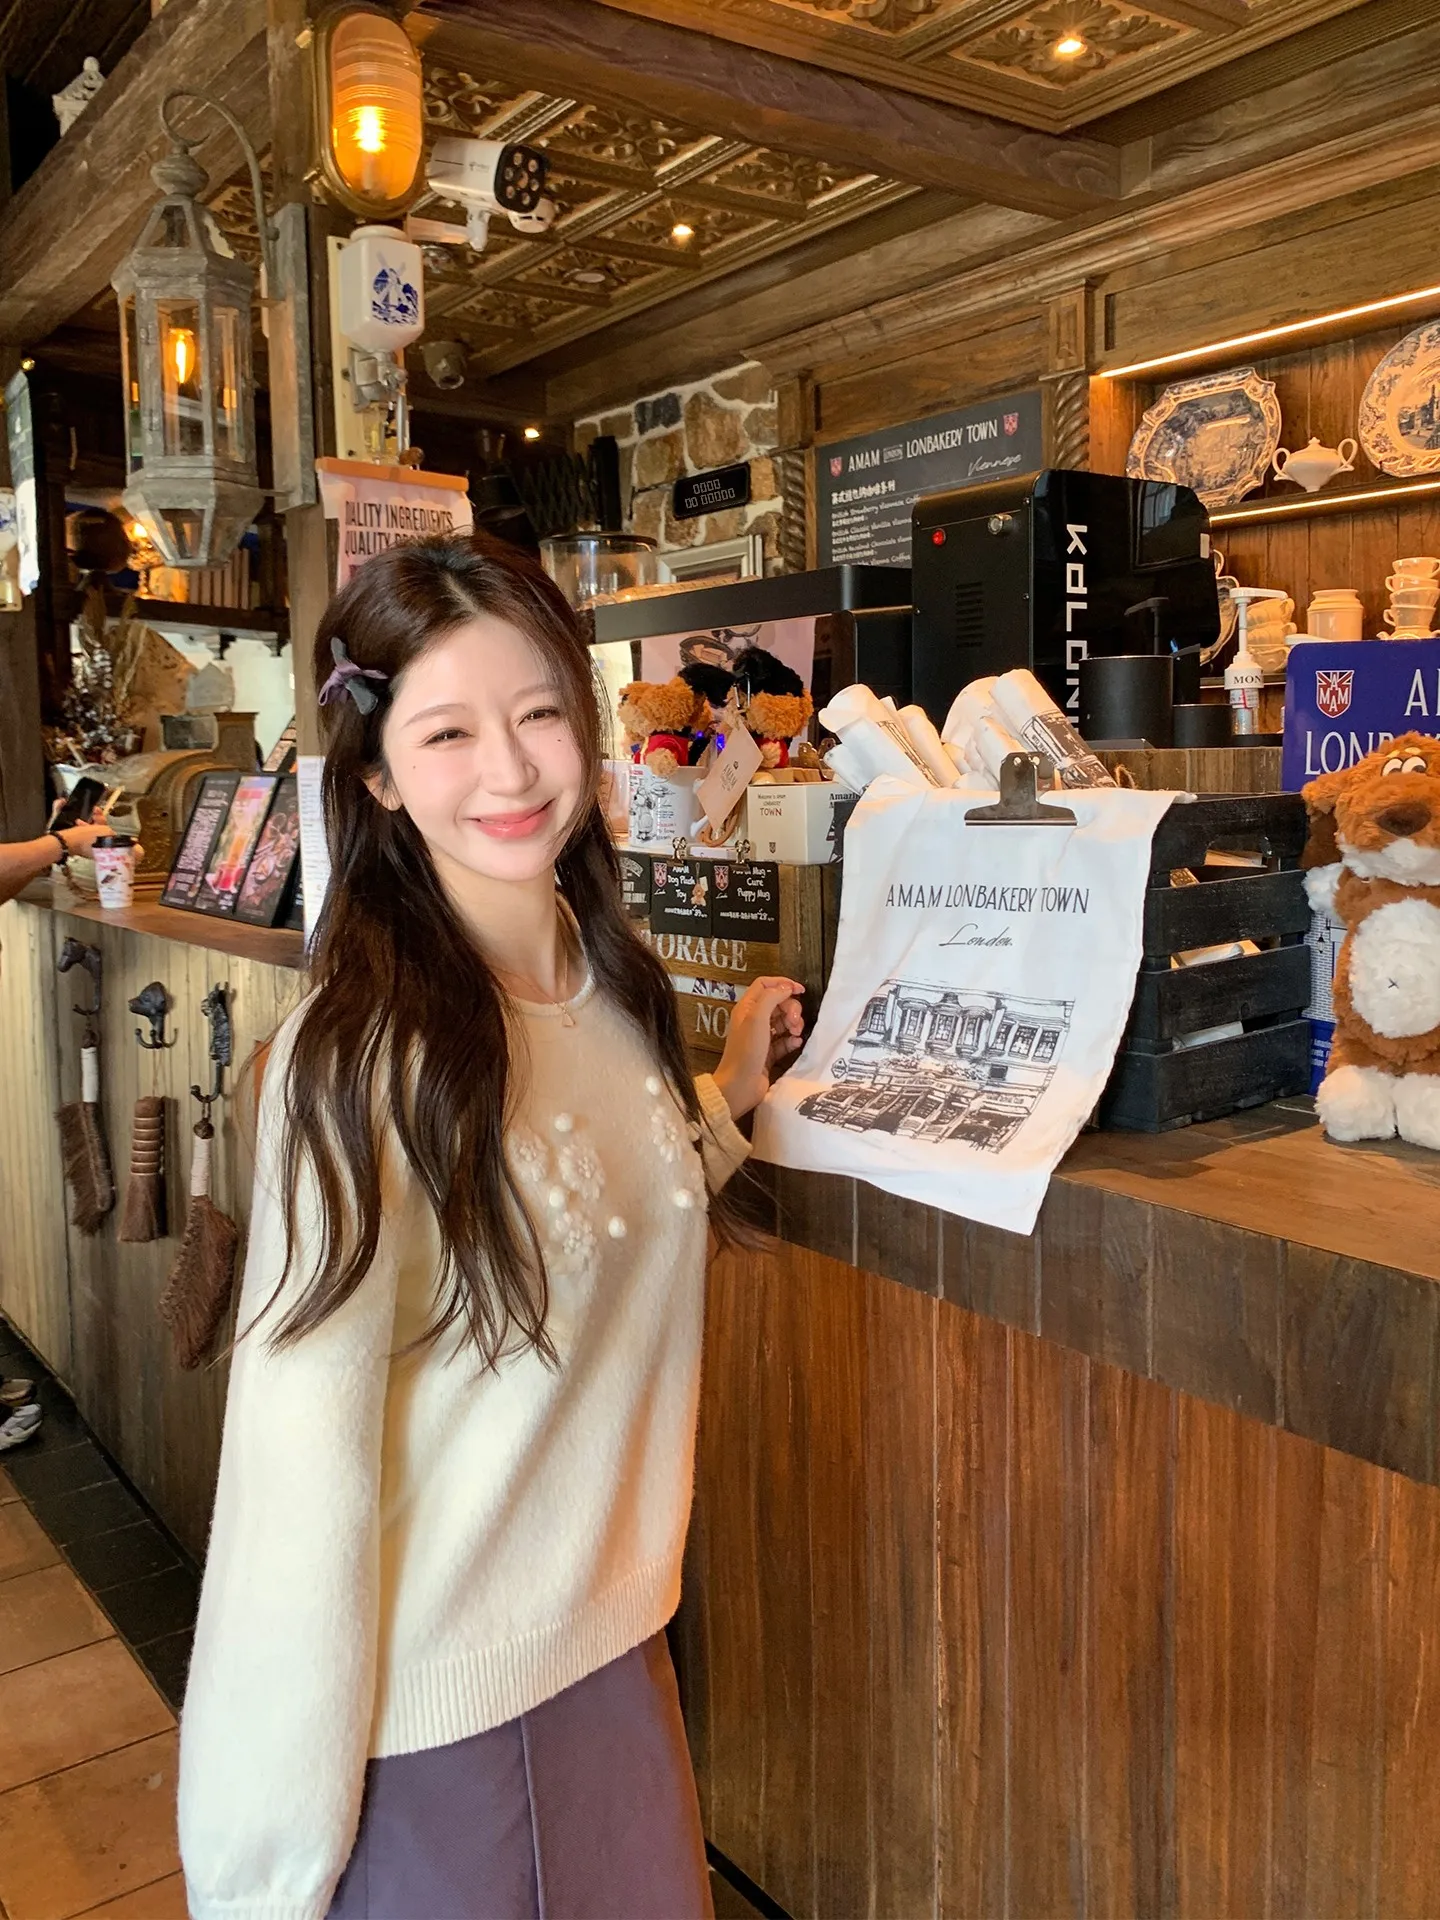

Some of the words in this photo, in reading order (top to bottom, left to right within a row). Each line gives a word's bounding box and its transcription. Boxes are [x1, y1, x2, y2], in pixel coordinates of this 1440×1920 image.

[848, 449, 881, 472] AMAM
[906, 428, 963, 458] LONBAKERY
[966, 419, 998, 444] TOWN
[675, 888, 687, 903] Toy
[885, 884, 944, 908] AMAM
[944, 884, 1038, 913] LONBAKERY
[1039, 887, 1090, 914] TOWN
[645, 930, 748, 972] ORAGE
